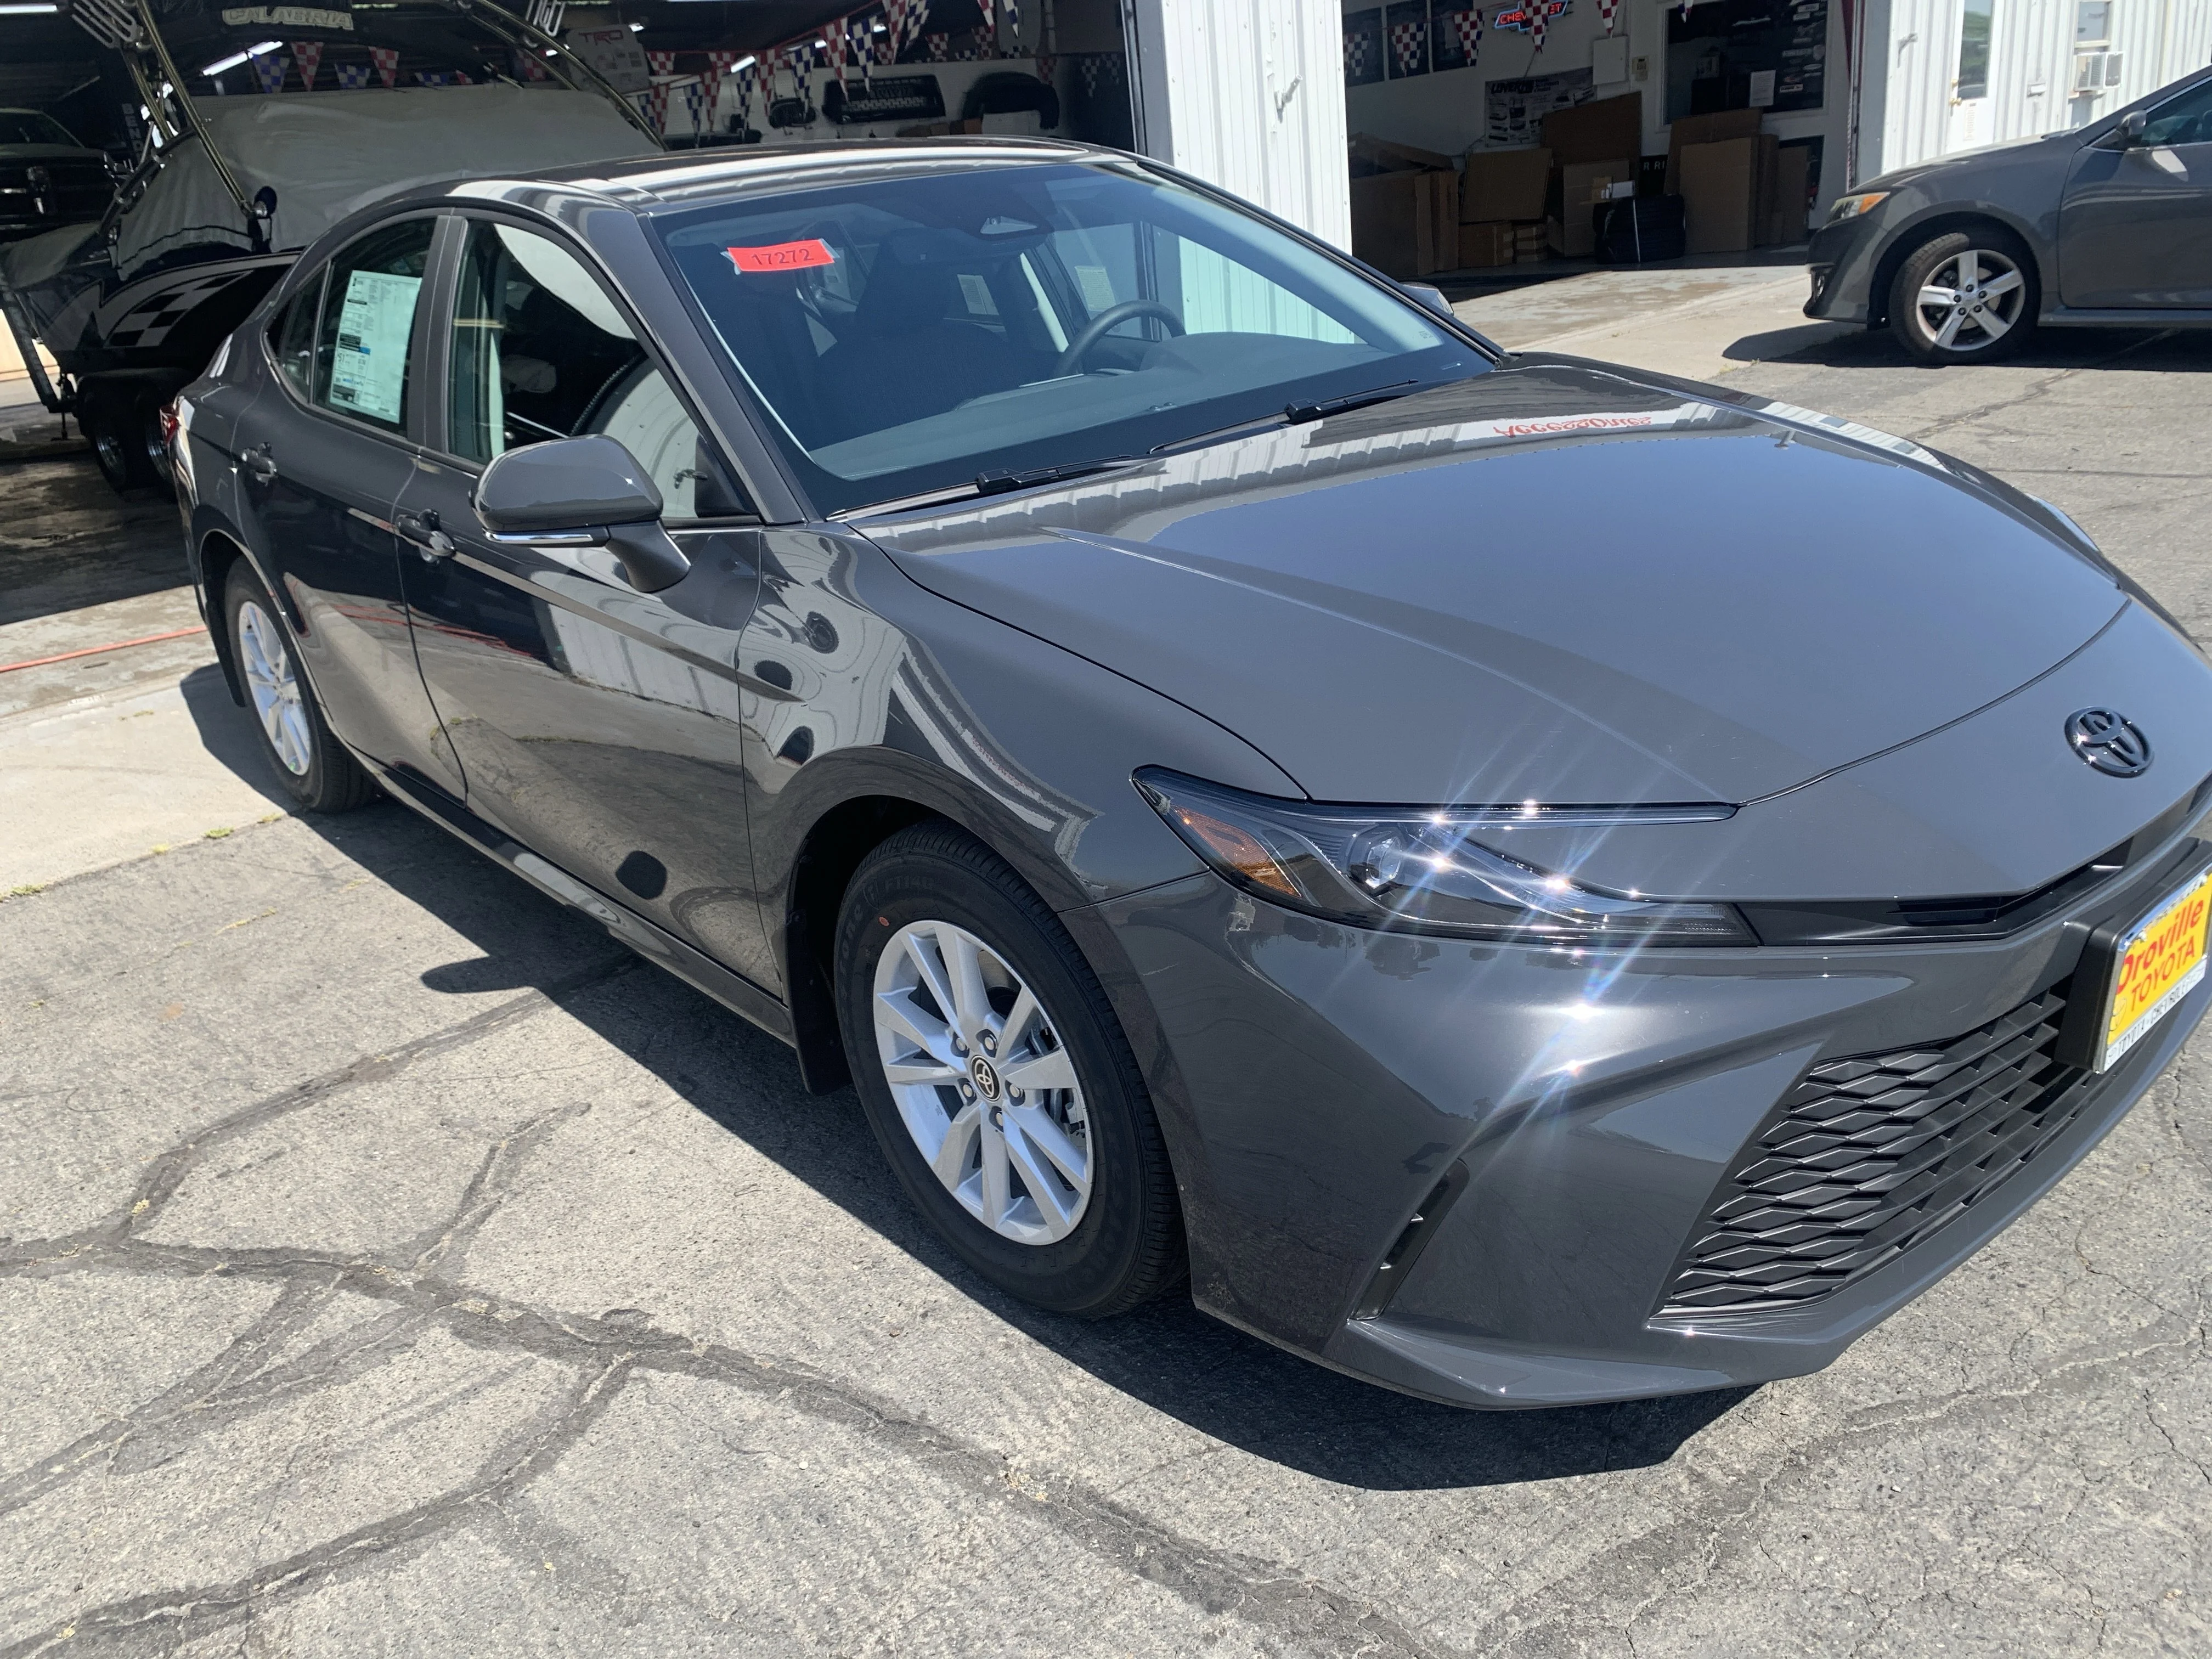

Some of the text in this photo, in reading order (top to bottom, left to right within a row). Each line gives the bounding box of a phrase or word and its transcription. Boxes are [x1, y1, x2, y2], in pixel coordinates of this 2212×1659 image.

[1500, 2, 1562, 24] CHEVET
[578, 30, 624, 46] TRD
[751, 249, 814, 265] 17272
[2115, 900, 2204, 995] Oroville
[2131, 935, 2195, 1012] TOYOTA
